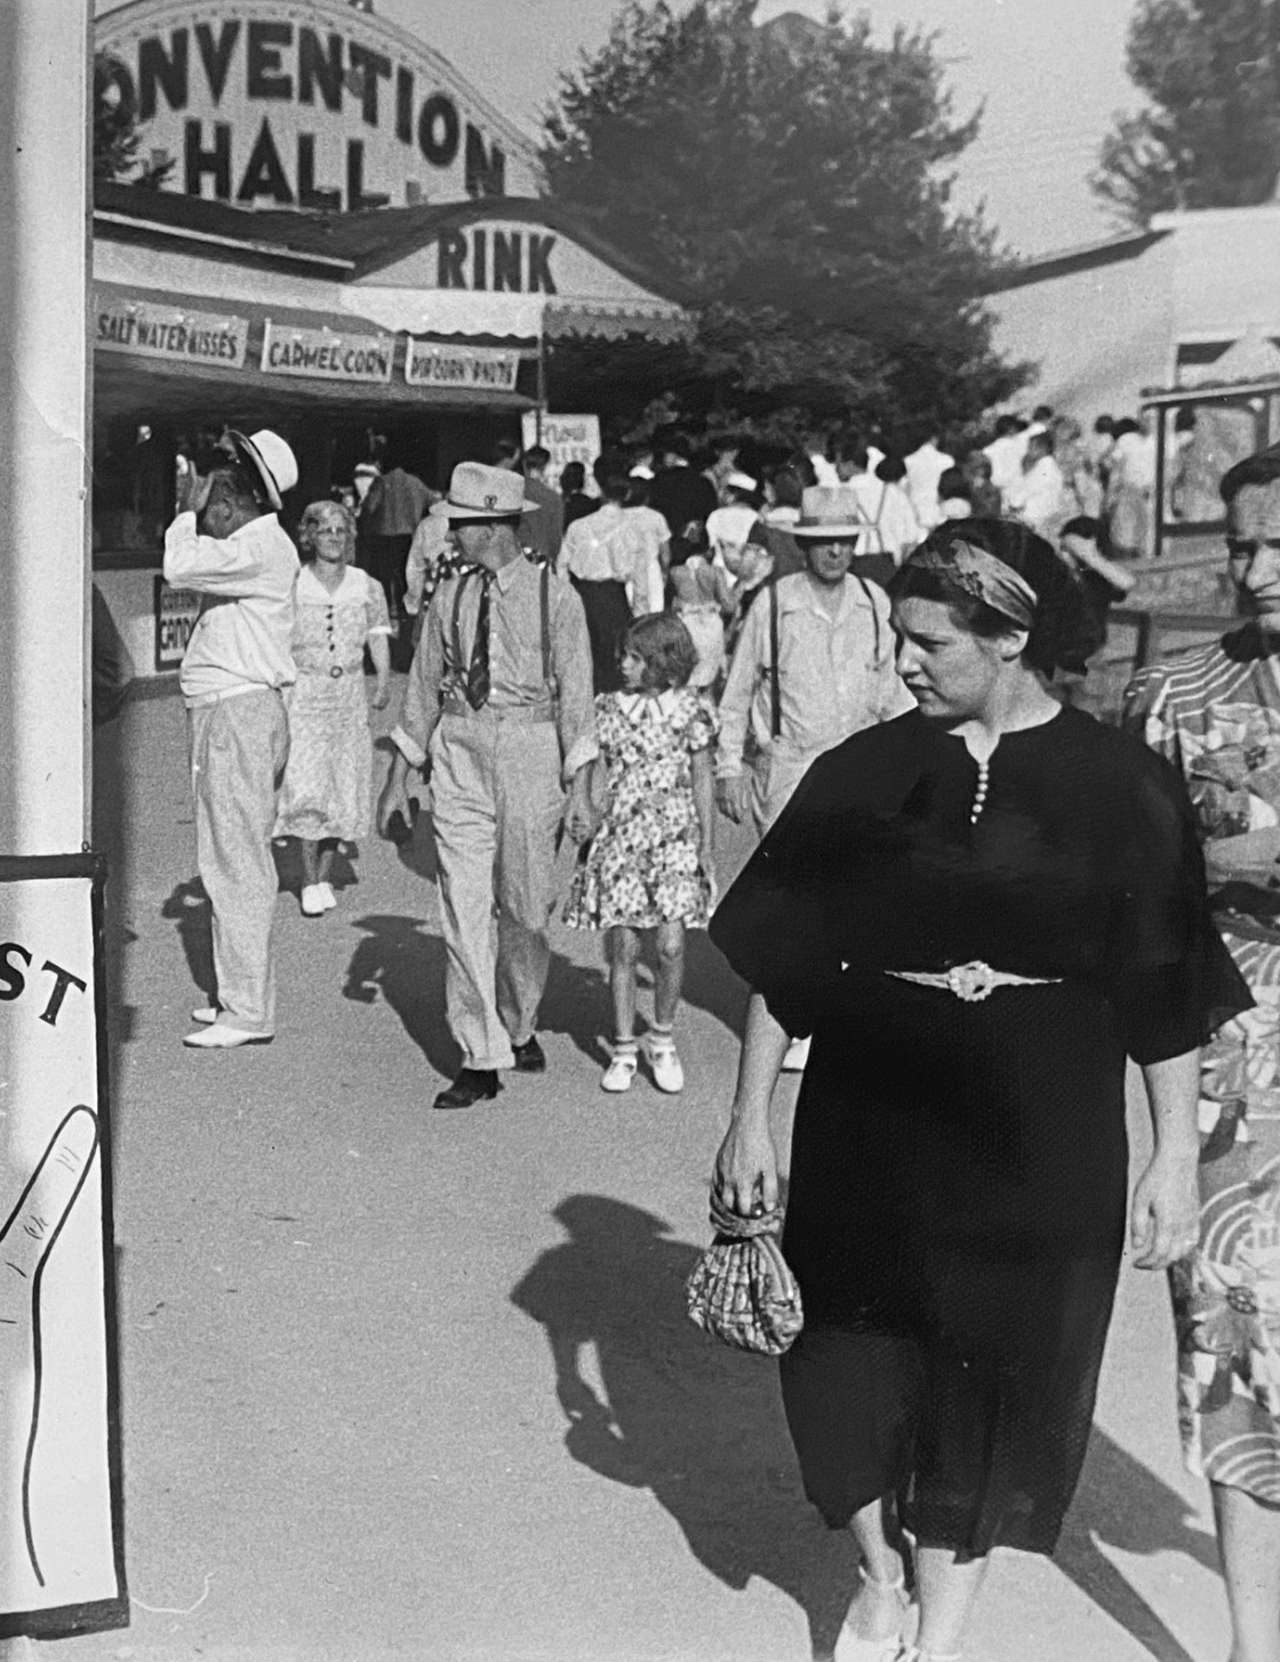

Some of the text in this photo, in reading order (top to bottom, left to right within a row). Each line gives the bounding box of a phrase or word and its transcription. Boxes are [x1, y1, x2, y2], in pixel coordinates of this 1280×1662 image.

[95, 20, 506, 198] ONVENTION
[184, 116, 391, 213] HALL
[436, 227, 558, 295] RINK
[96, 313, 136, 345] SALT
[138, 322, 186, 353] WATER
[269, 342, 389, 376] CARMEL CORN
